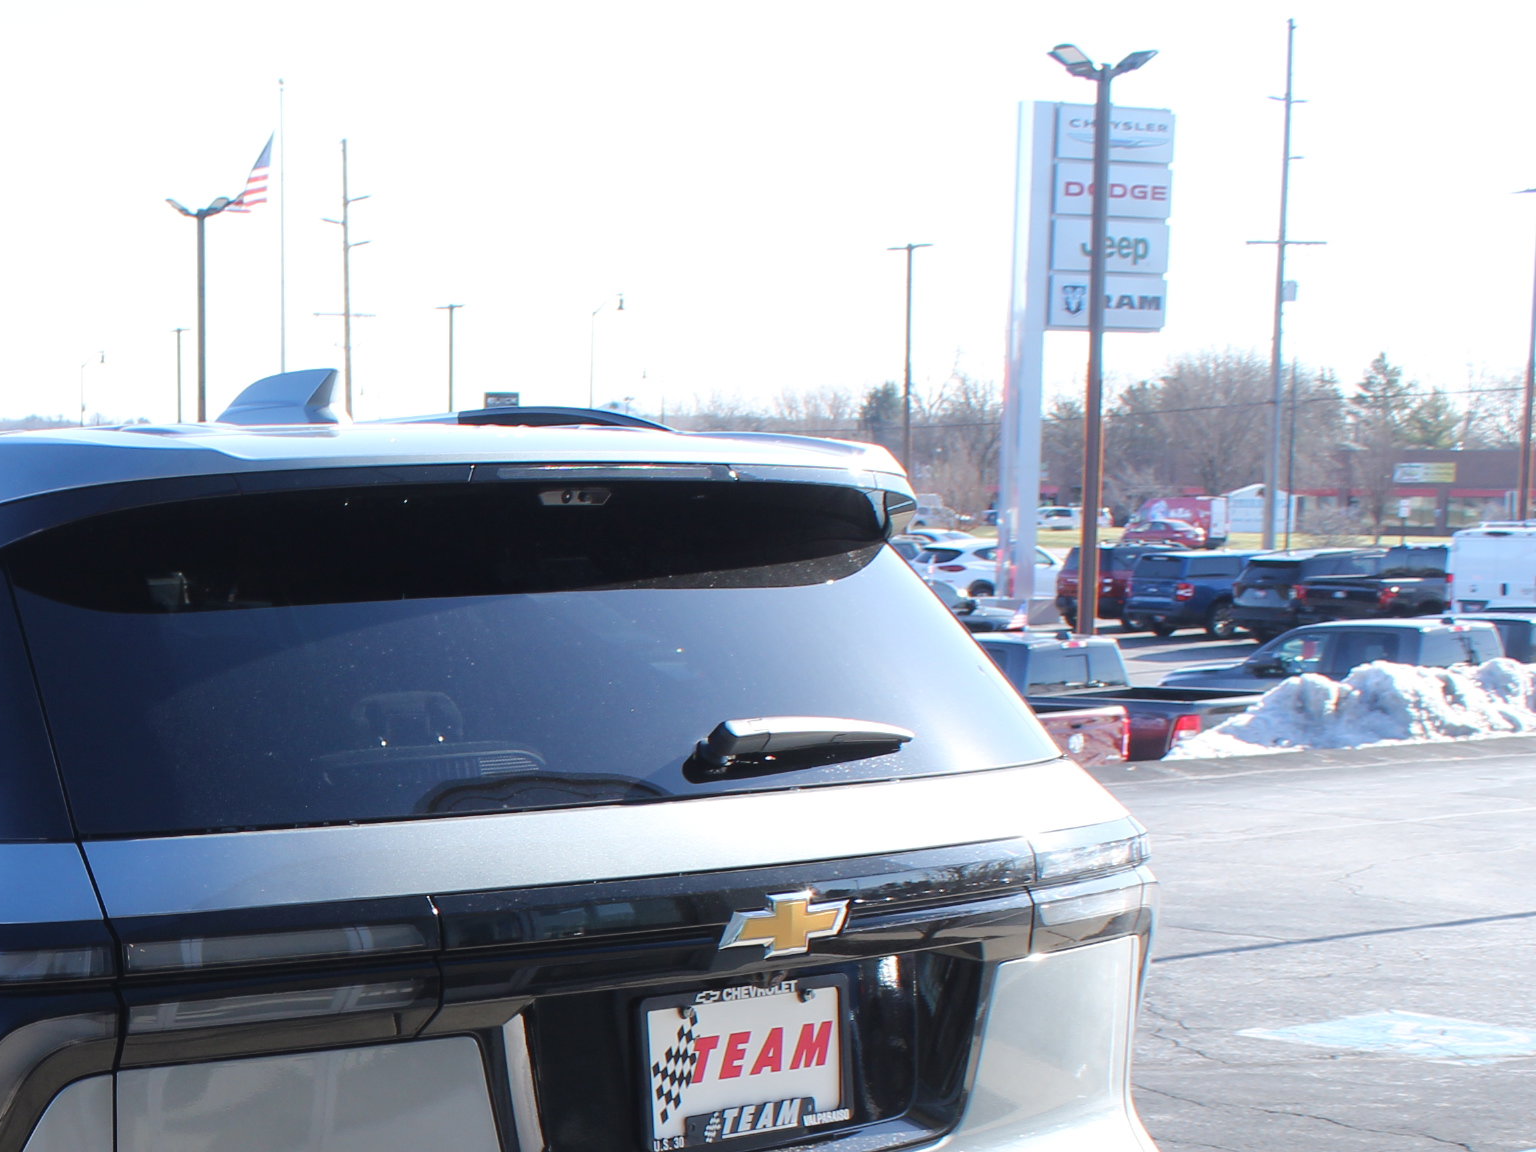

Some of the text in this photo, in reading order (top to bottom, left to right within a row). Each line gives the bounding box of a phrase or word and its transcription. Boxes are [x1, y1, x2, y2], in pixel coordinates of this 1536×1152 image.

[1068, 118, 1169, 132] CHYSLER
[722, 979, 799, 1001] CHEVROLET
[691, 1020, 833, 1084] TEAM
[722, 1098, 802, 1135] TEAM
[673, 1136, 685, 1150] 30
